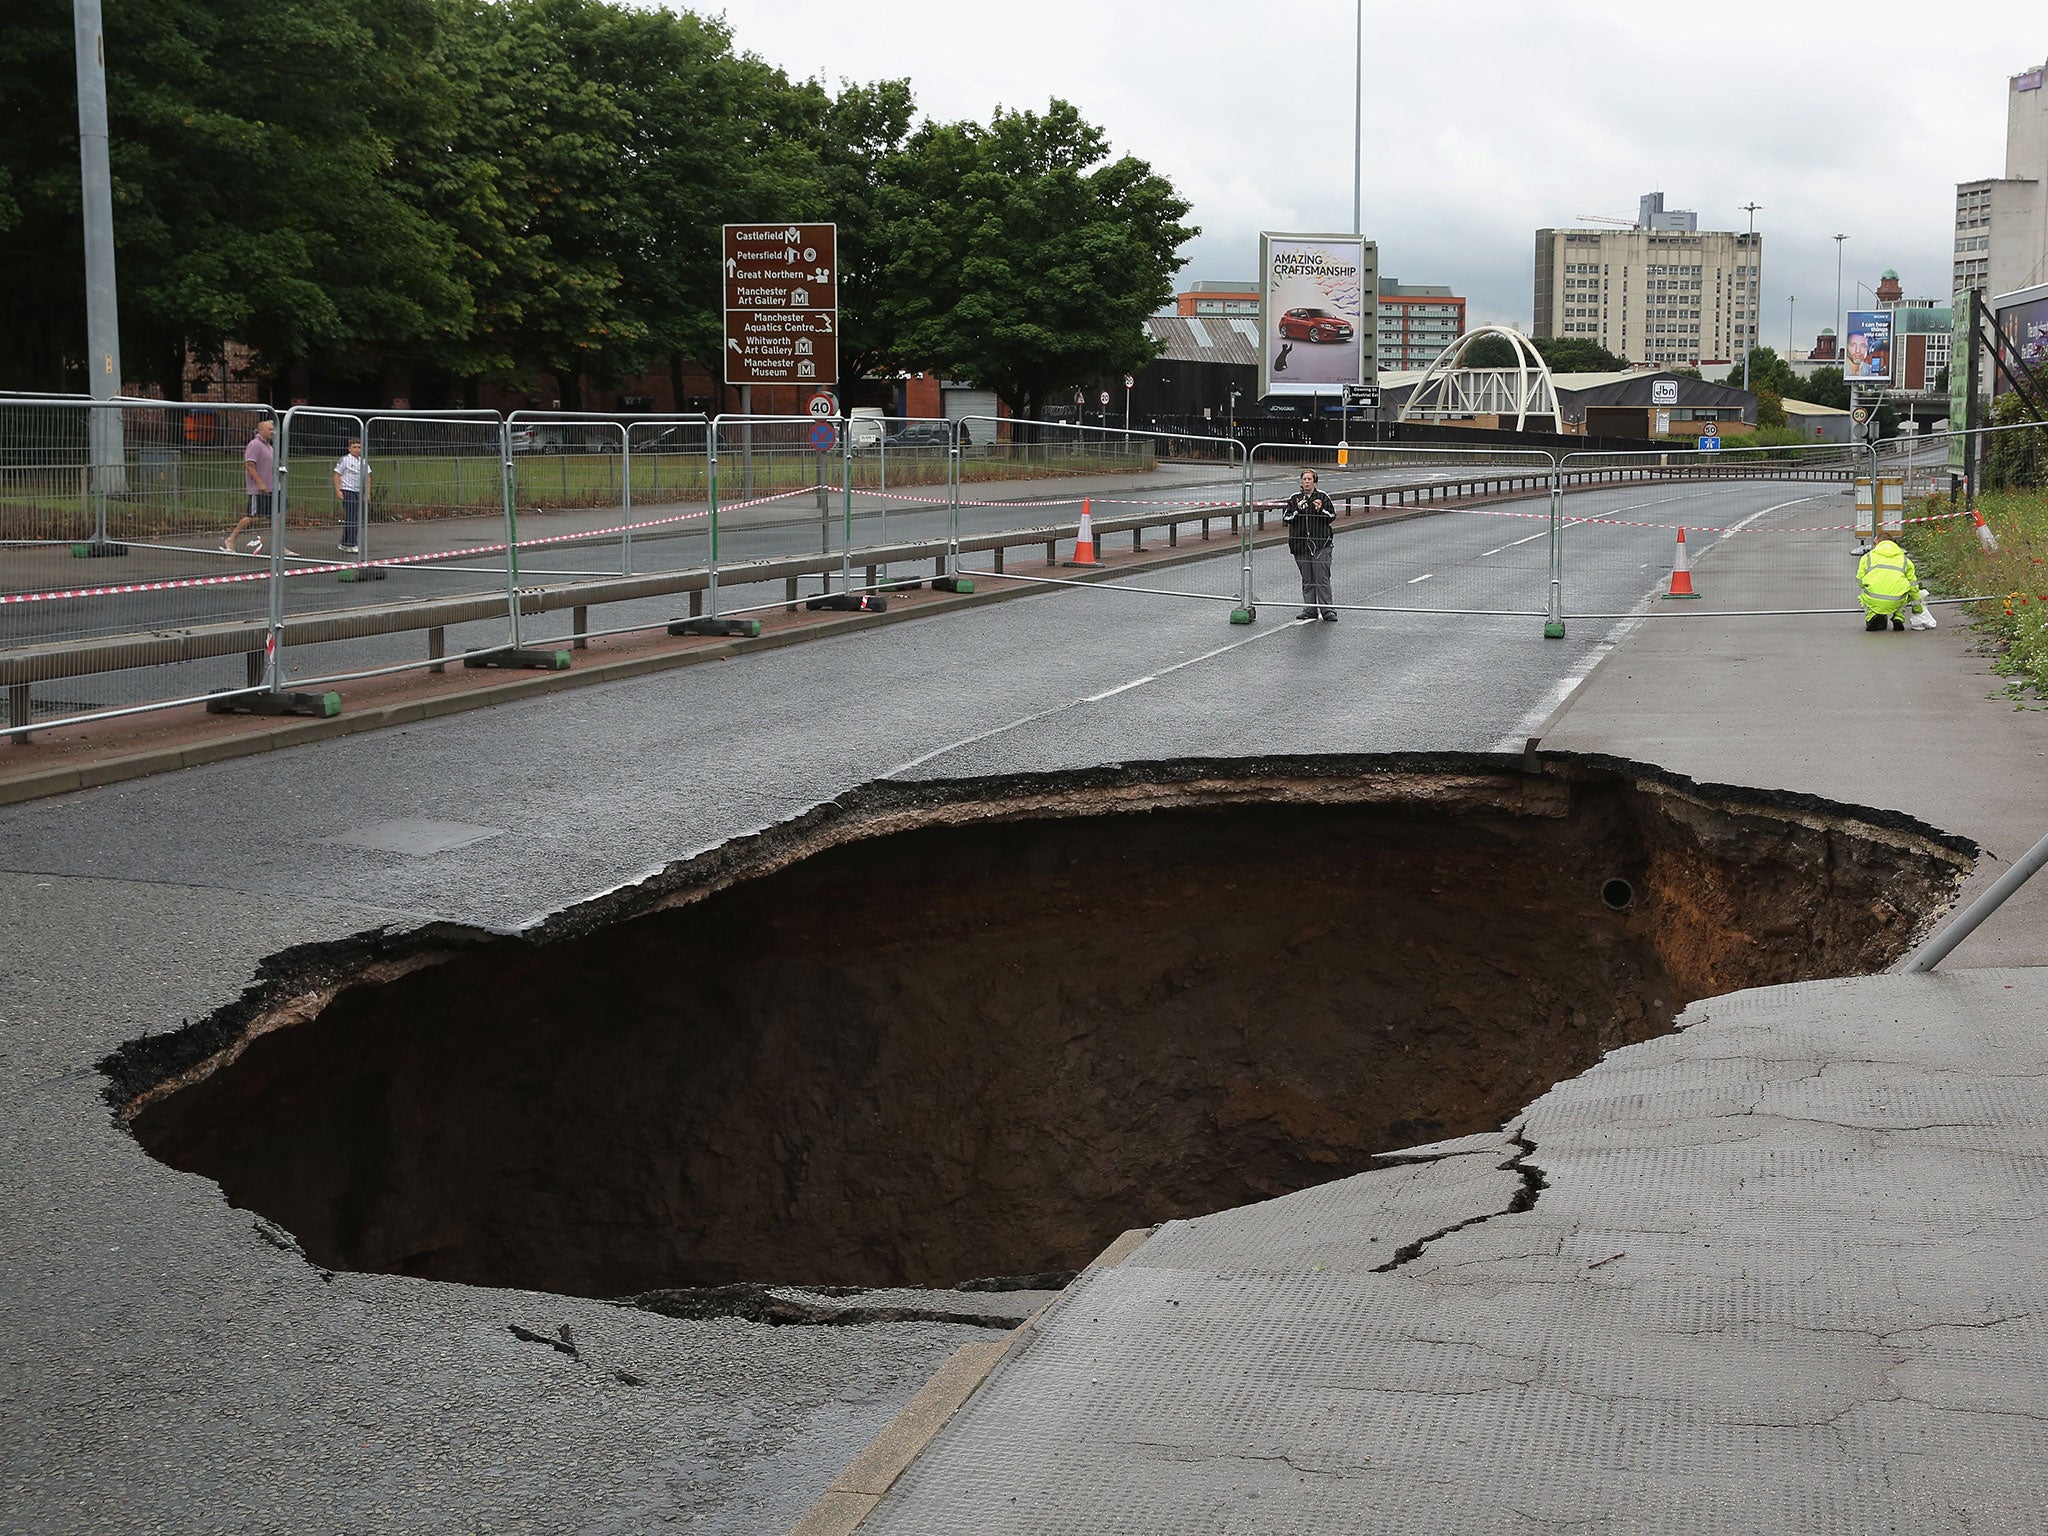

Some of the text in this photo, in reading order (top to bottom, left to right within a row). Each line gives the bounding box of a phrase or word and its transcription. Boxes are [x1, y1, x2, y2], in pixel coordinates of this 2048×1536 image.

[736, 231, 783, 240] Castlefield
[737, 251, 783, 260] Petersfield
[1274, 254, 1323, 265] AMAZING
[736, 270, 804, 279] Great Northern
[1274, 264, 1357, 276] CRAFTSMANSHIP
[737, 287, 787, 296] Manchester
[738, 296, 787, 306] Art Gallery
[754, 313, 804, 322] Manchester
[744, 323, 815, 333] Aquatics Centre
[746, 336, 791, 345] Whitworth
[744, 346, 793, 356] Art Gallery
[744, 358, 795, 367] Manchester
[752, 368, 788, 376] Museum
[811, 402, 829, 414] 40
[1855, 411, 1865, 419] 50
[1705, 426, 1716, 434] 50
